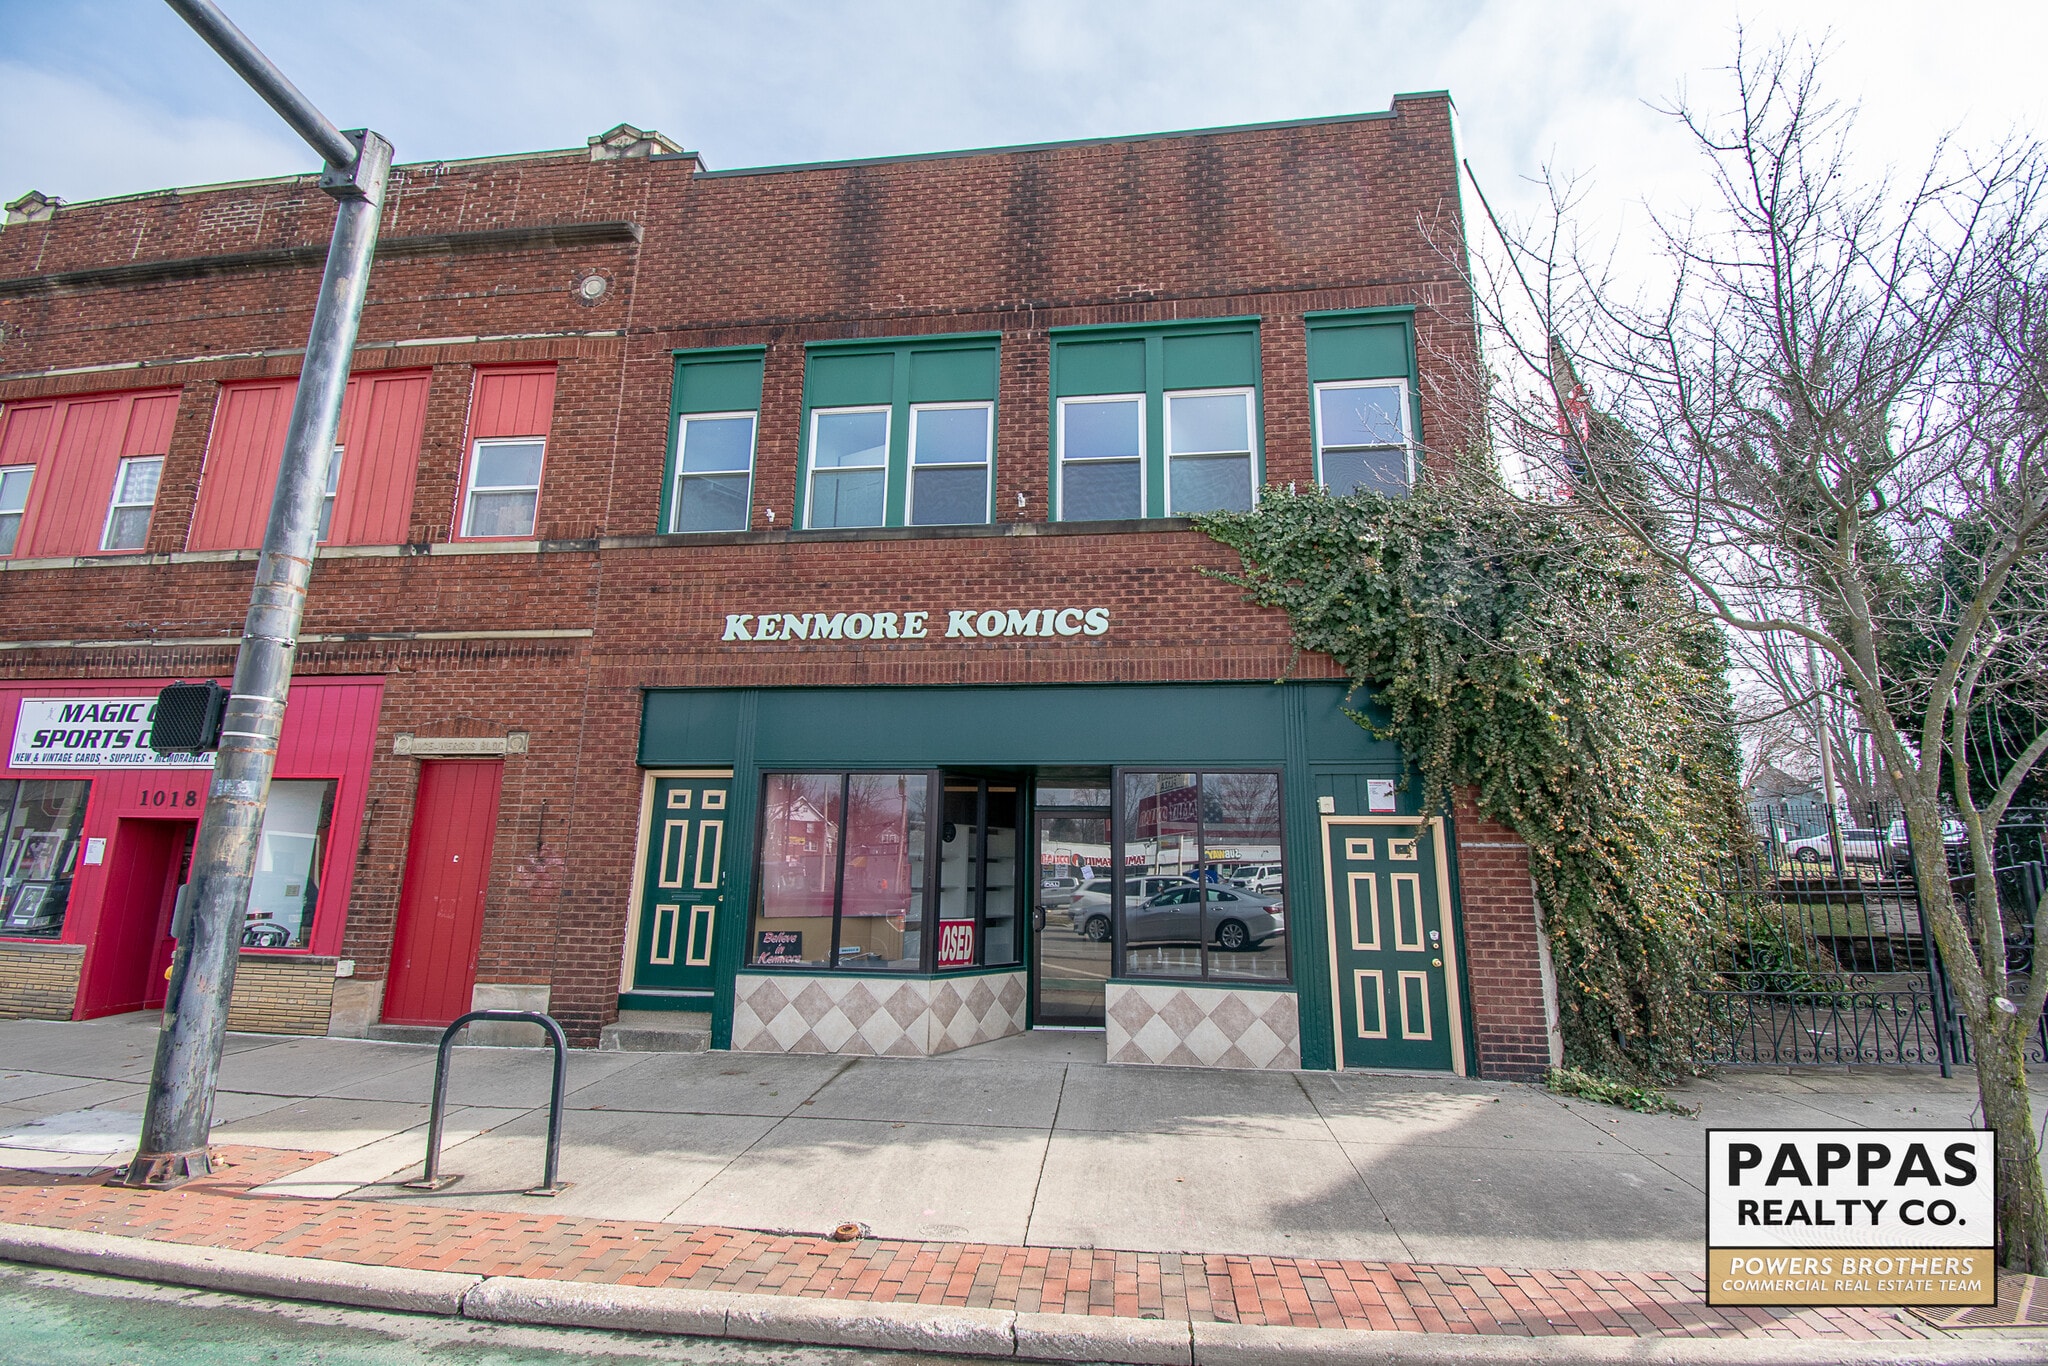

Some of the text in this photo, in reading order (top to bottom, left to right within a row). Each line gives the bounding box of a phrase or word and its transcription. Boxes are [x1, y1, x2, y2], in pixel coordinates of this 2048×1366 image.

[721, 607, 1110, 642] KENMORE KOMICS
[58, 703, 145, 723] MAGIC
[30, 729, 134, 749] SPORTS
[14, 753, 31, 762] NEW
[33, 753, 39, 762] &
[41, 753, 74, 763] VINTAGE
[75, 753, 101, 763] CARDS
[109, 753, 147, 763] SUPPLIES
[139, 790, 197, 807] 1018
[763, 932, 798, 944] Believe
[938, 925, 973, 961] OSED
[775, 943, 785, 954] in
[757, 952, 802, 964] Kenmore
